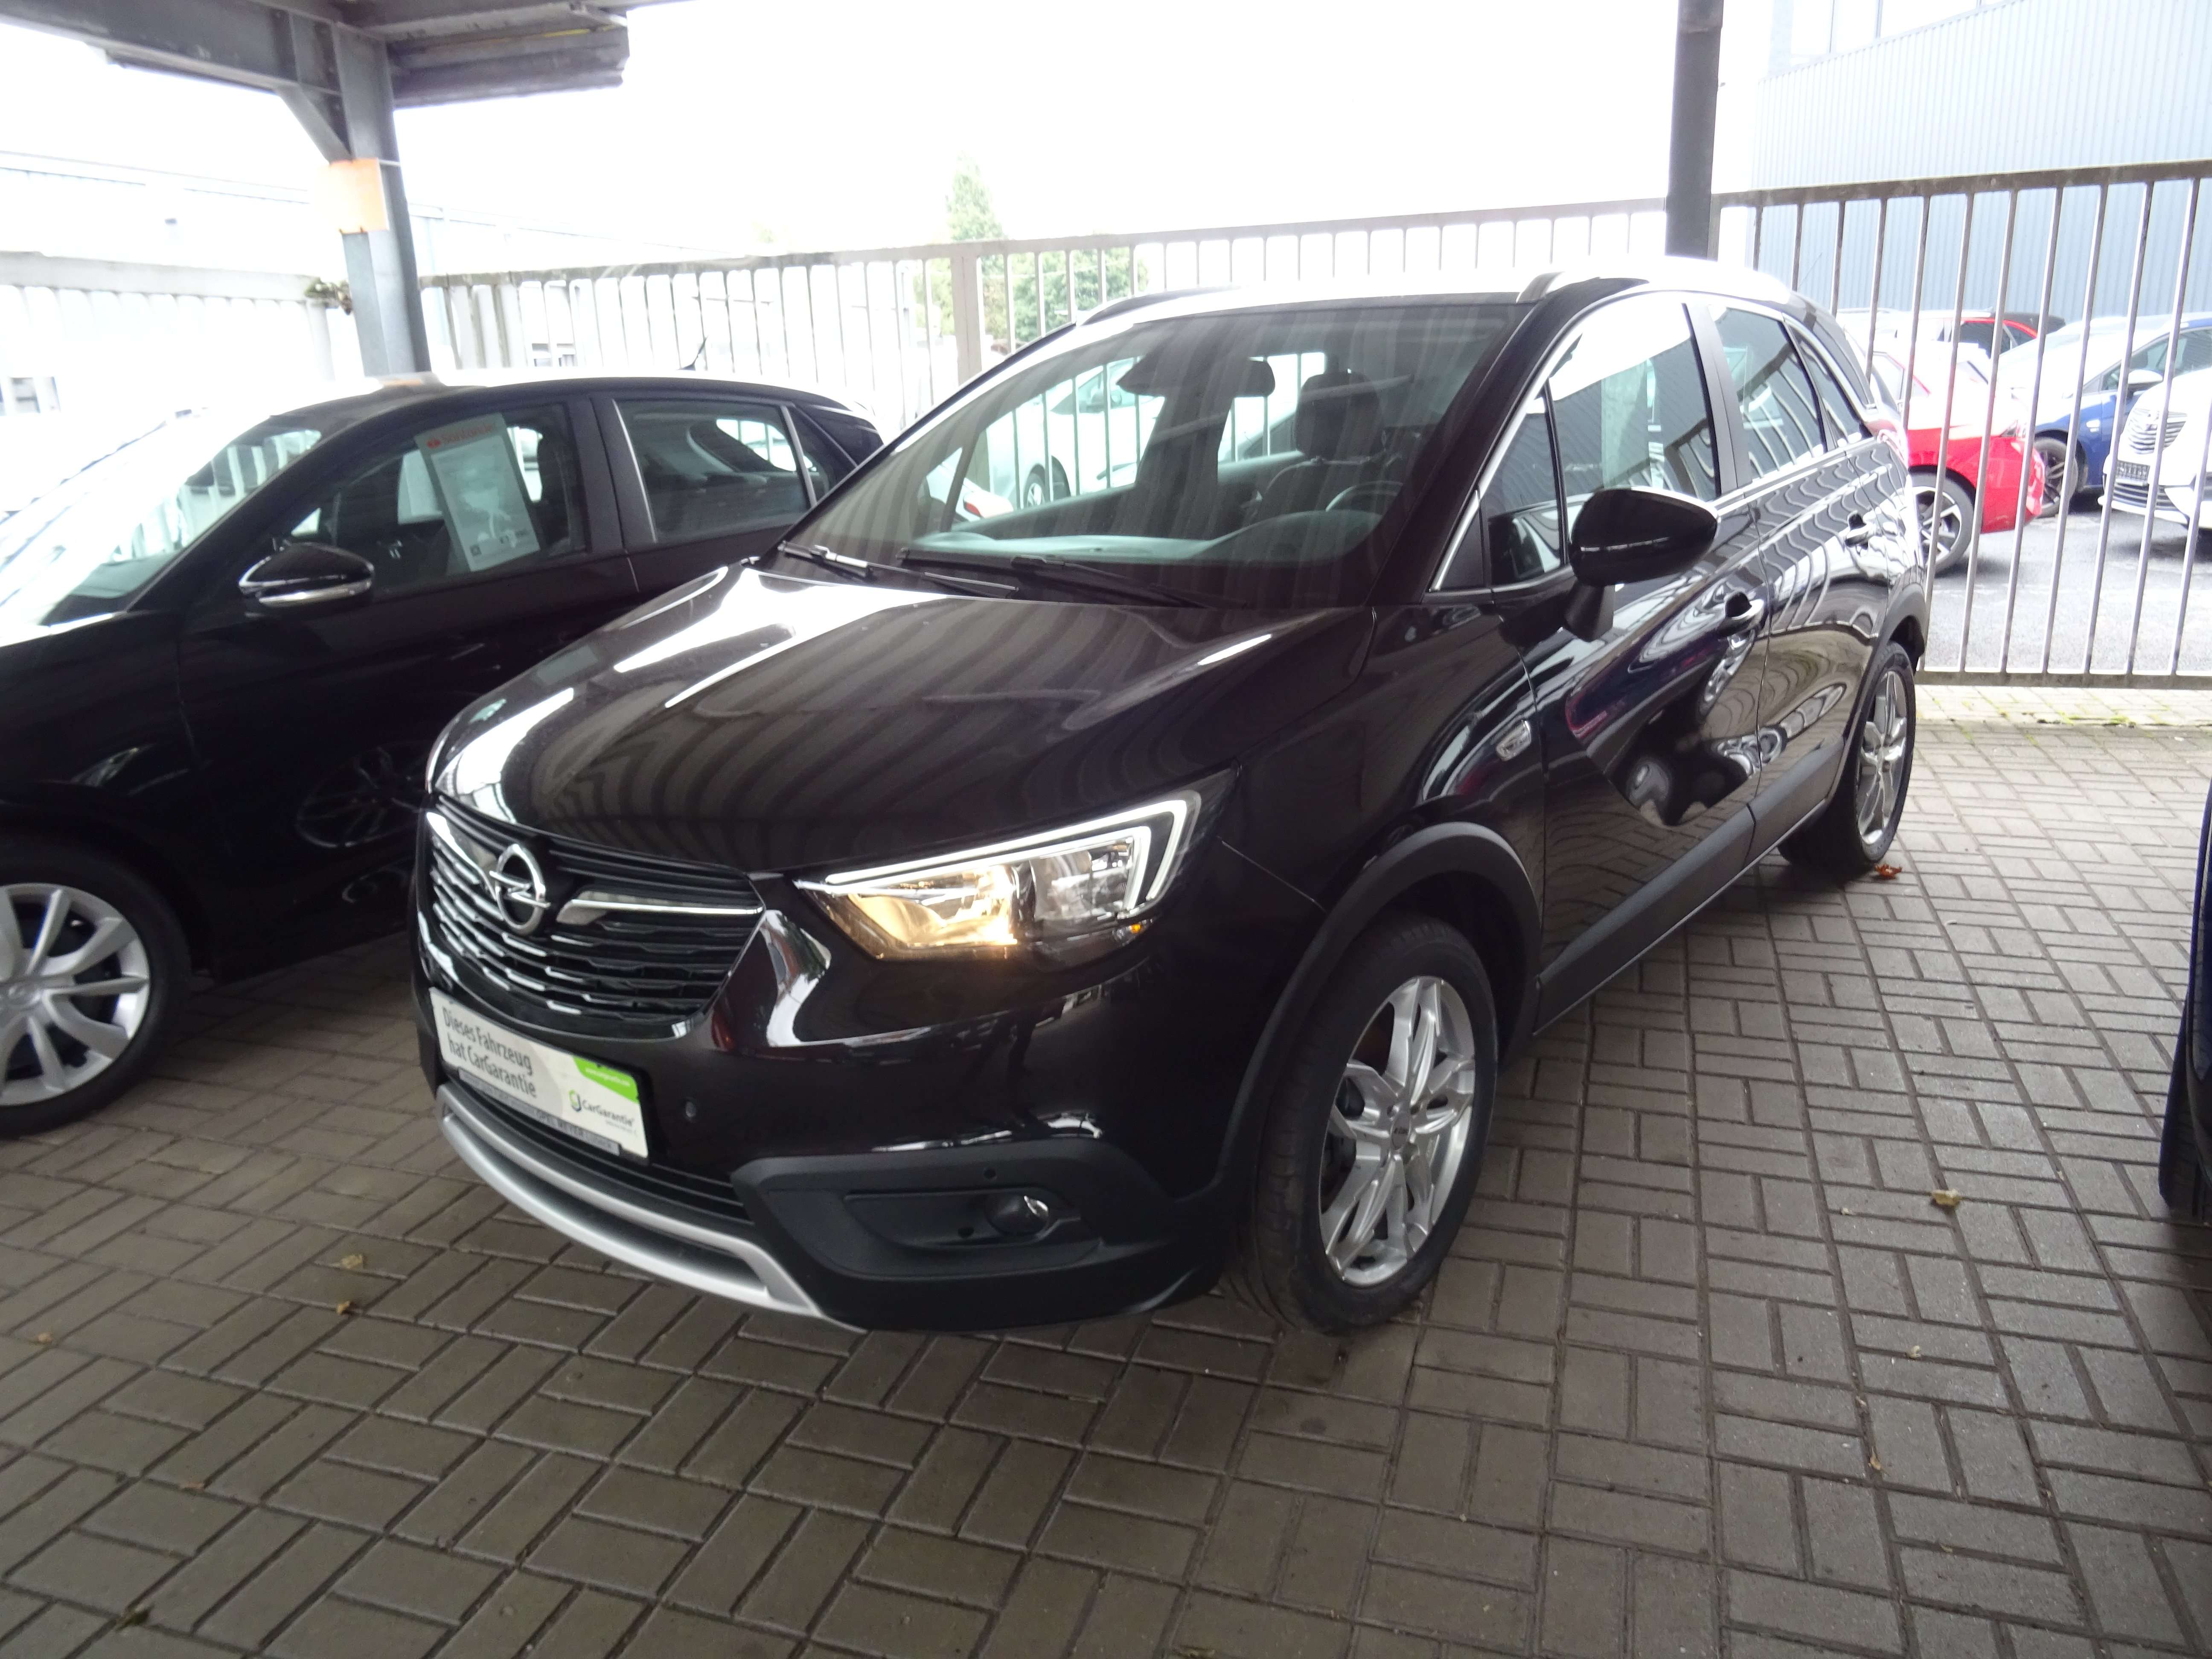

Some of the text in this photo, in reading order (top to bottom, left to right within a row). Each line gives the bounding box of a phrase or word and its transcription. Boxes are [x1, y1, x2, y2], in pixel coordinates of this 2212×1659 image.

[442, 1006, 533, 1077] Dieses Fahrzeug
[447, 1032, 467, 1062] hat
[468, 1045, 537, 1098] CarGarantie
